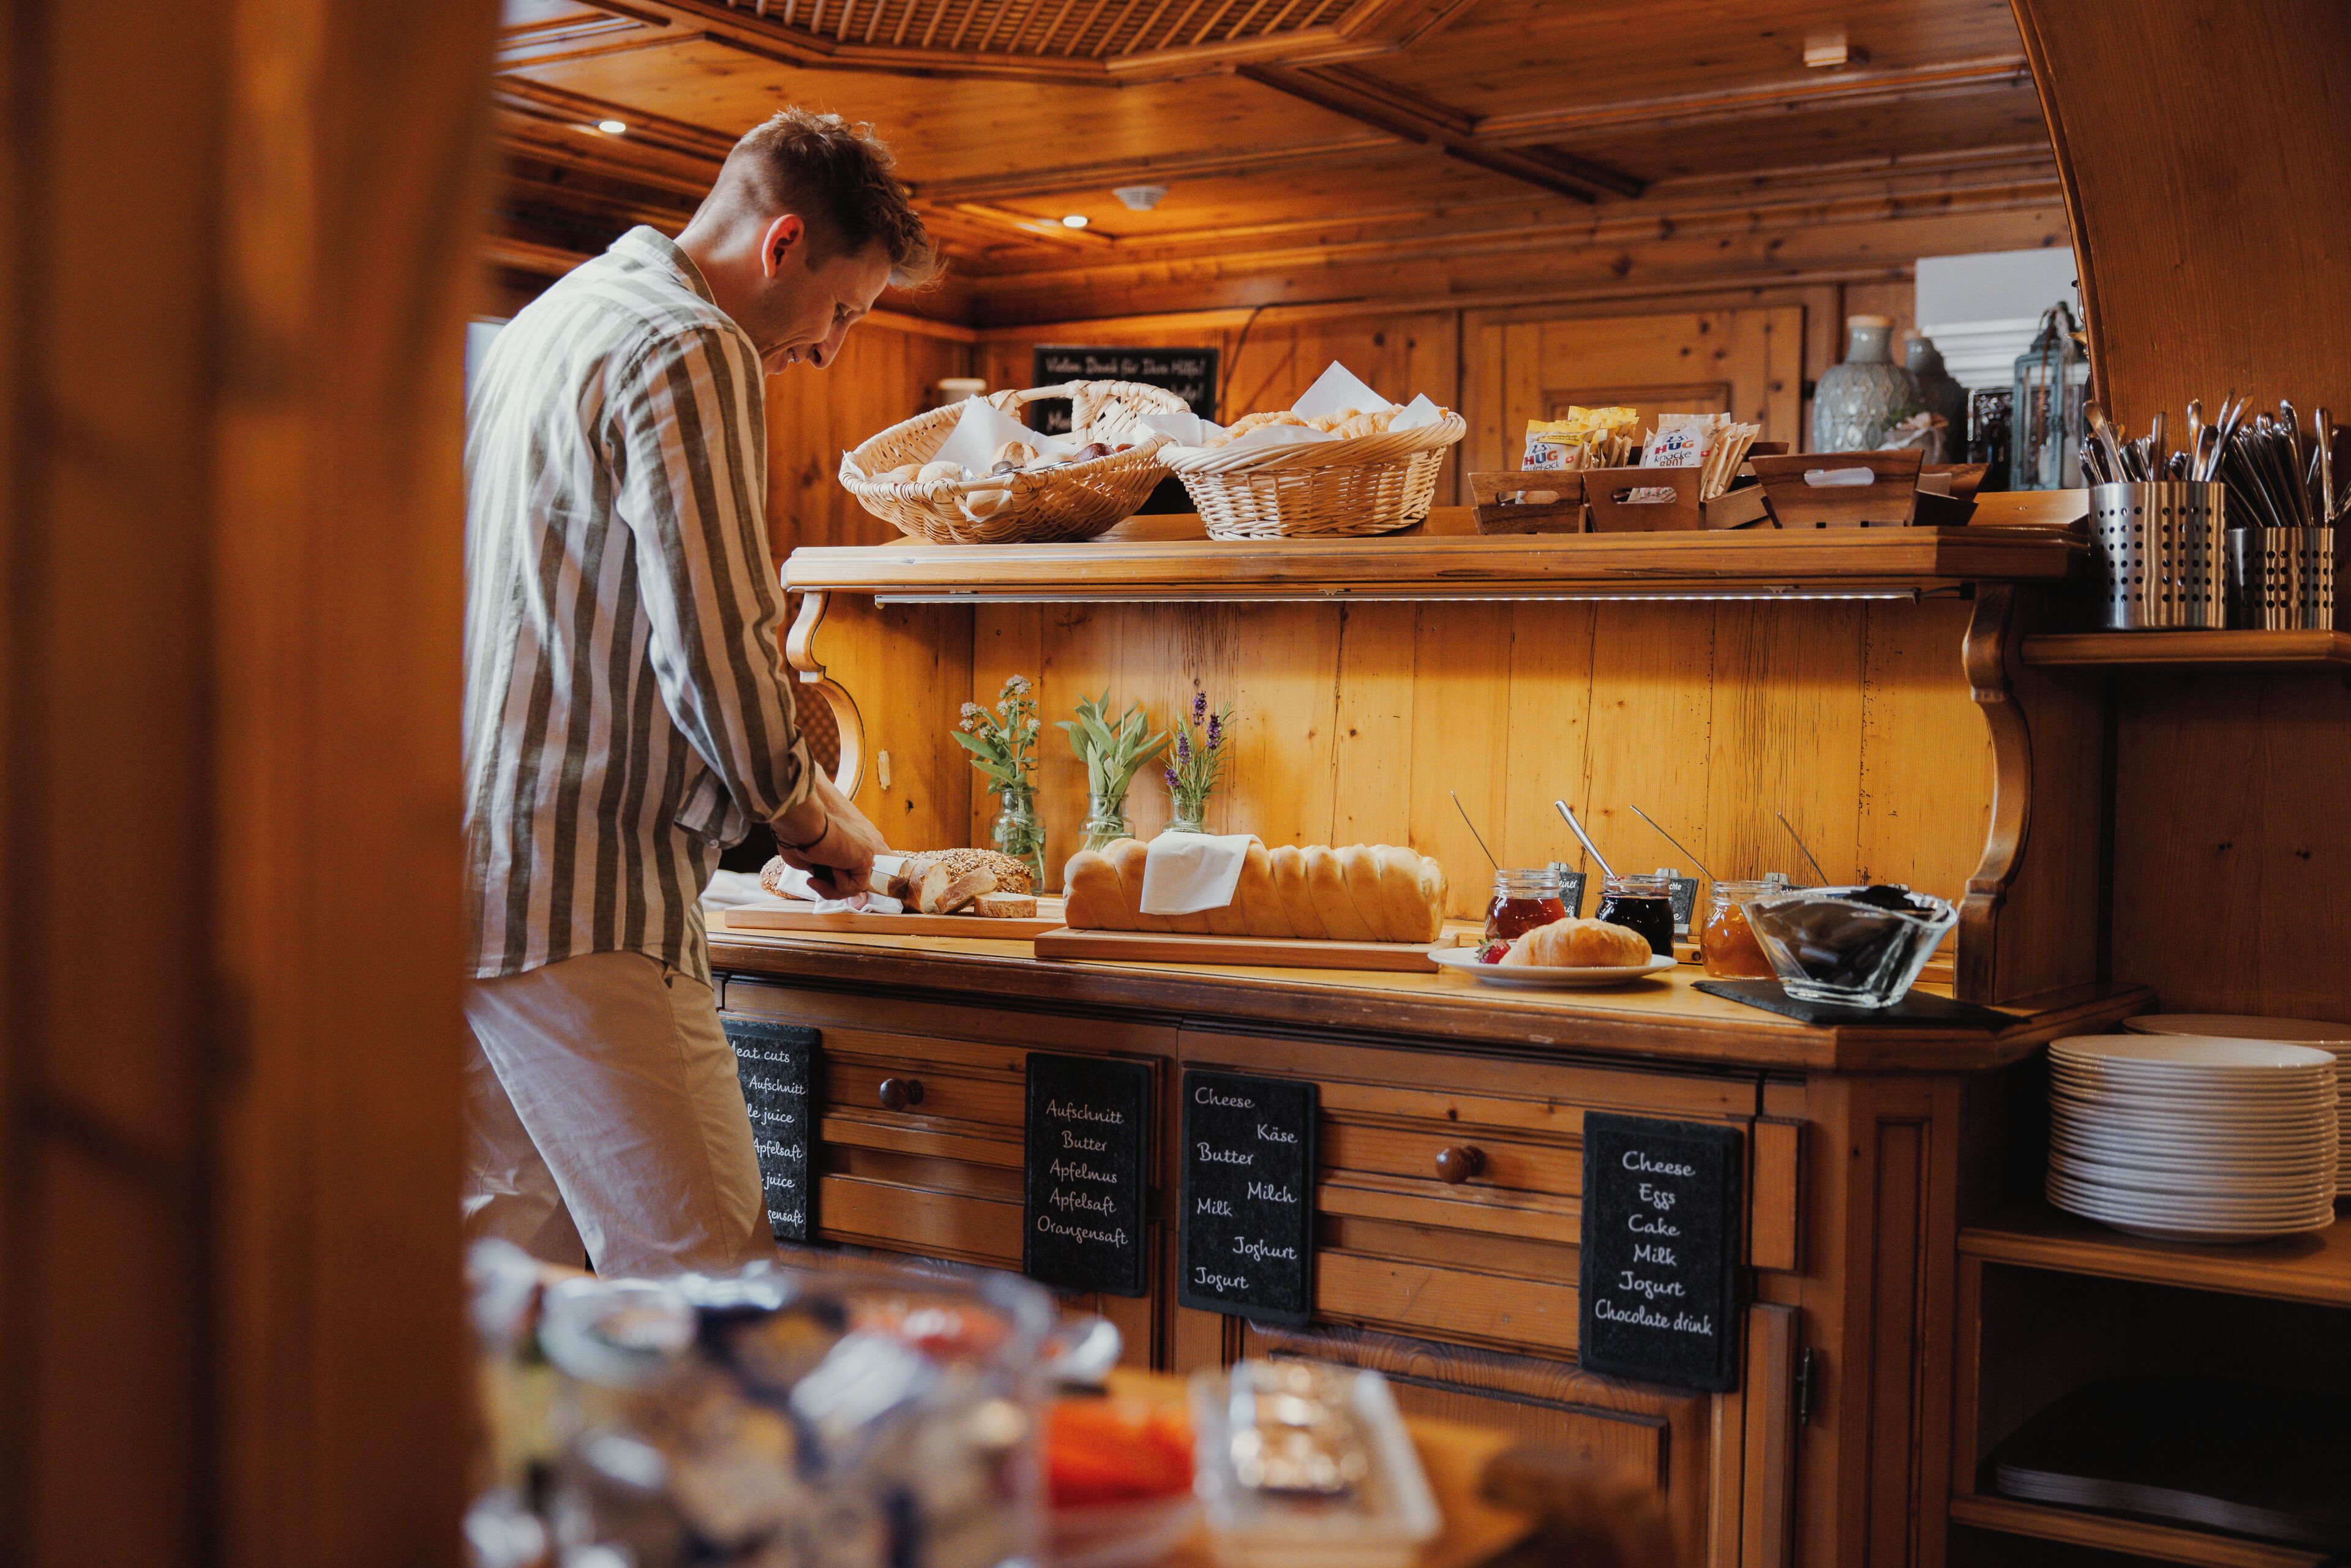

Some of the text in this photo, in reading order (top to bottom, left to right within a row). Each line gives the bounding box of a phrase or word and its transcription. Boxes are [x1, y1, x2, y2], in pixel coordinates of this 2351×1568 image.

[1524, 451, 1558, 465] HUG
[1655, 440, 1694, 454] HUG
[764, 1051, 790, 1063] cuts
[749, 1075, 806, 1095] Aufschnitt
[1195, 1087, 1255, 1108] Cheese
[761, 1108, 795, 1125] juice
[1046, 1100, 1124, 1124] Aufschnitt
[1062, 1130, 1107, 1152] Butter
[1257, 1123, 1298, 1143] Käse
[1197, 1142, 1254, 1165] Butter
[1622, 1150, 1696, 1177] Cheese
[763, 1172, 795, 1190] juice
[1049, 1158, 1117, 1184] Apfelmus
[1049, 1188, 1117, 1217] Apfelsaft
[1247, 1182, 1297, 1203] Milch
[1639, 1183, 1676, 1211] Eggs
[1197, 1198, 1232, 1217] Milk
[1038, 1215, 1128, 1248] Orangensaft
[1627, 1214, 1681, 1237] Cake
[1232, 1237, 1297, 1261] Joghurt
[1633, 1244, 1678, 1267] Milk
[1194, 1267, 1250, 1292] Jogurt
[1619, 1270, 1685, 1299] Jogurt
[1595, 1299, 1712, 1336] Chocolate drink
